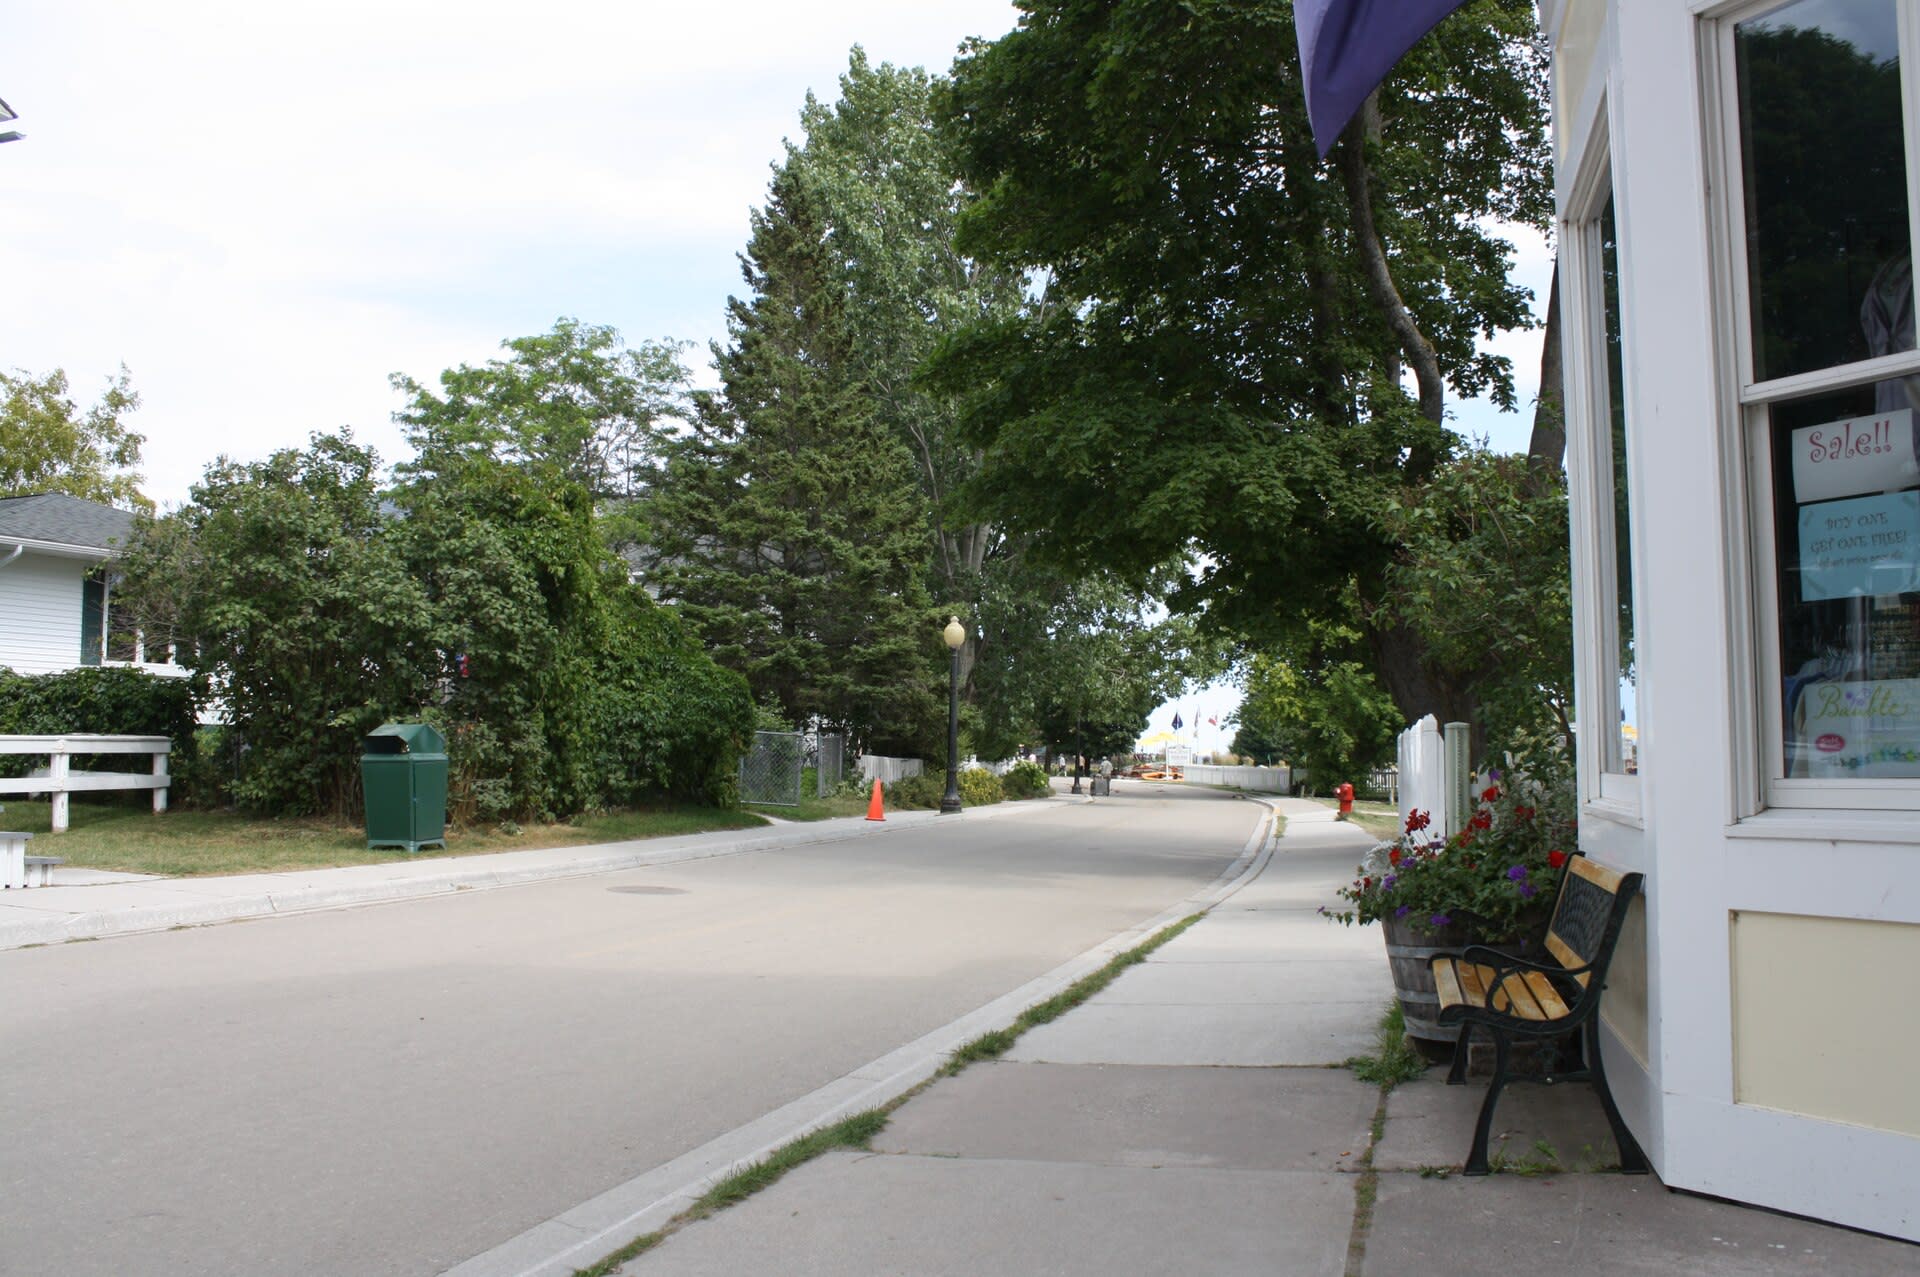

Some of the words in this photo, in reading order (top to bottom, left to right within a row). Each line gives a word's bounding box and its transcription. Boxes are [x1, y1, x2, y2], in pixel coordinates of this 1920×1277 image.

[1808, 420, 1892, 463] Sale!!
[1857, 512, 1888, 526] ONE
[1838, 535, 1867, 549] ONE
